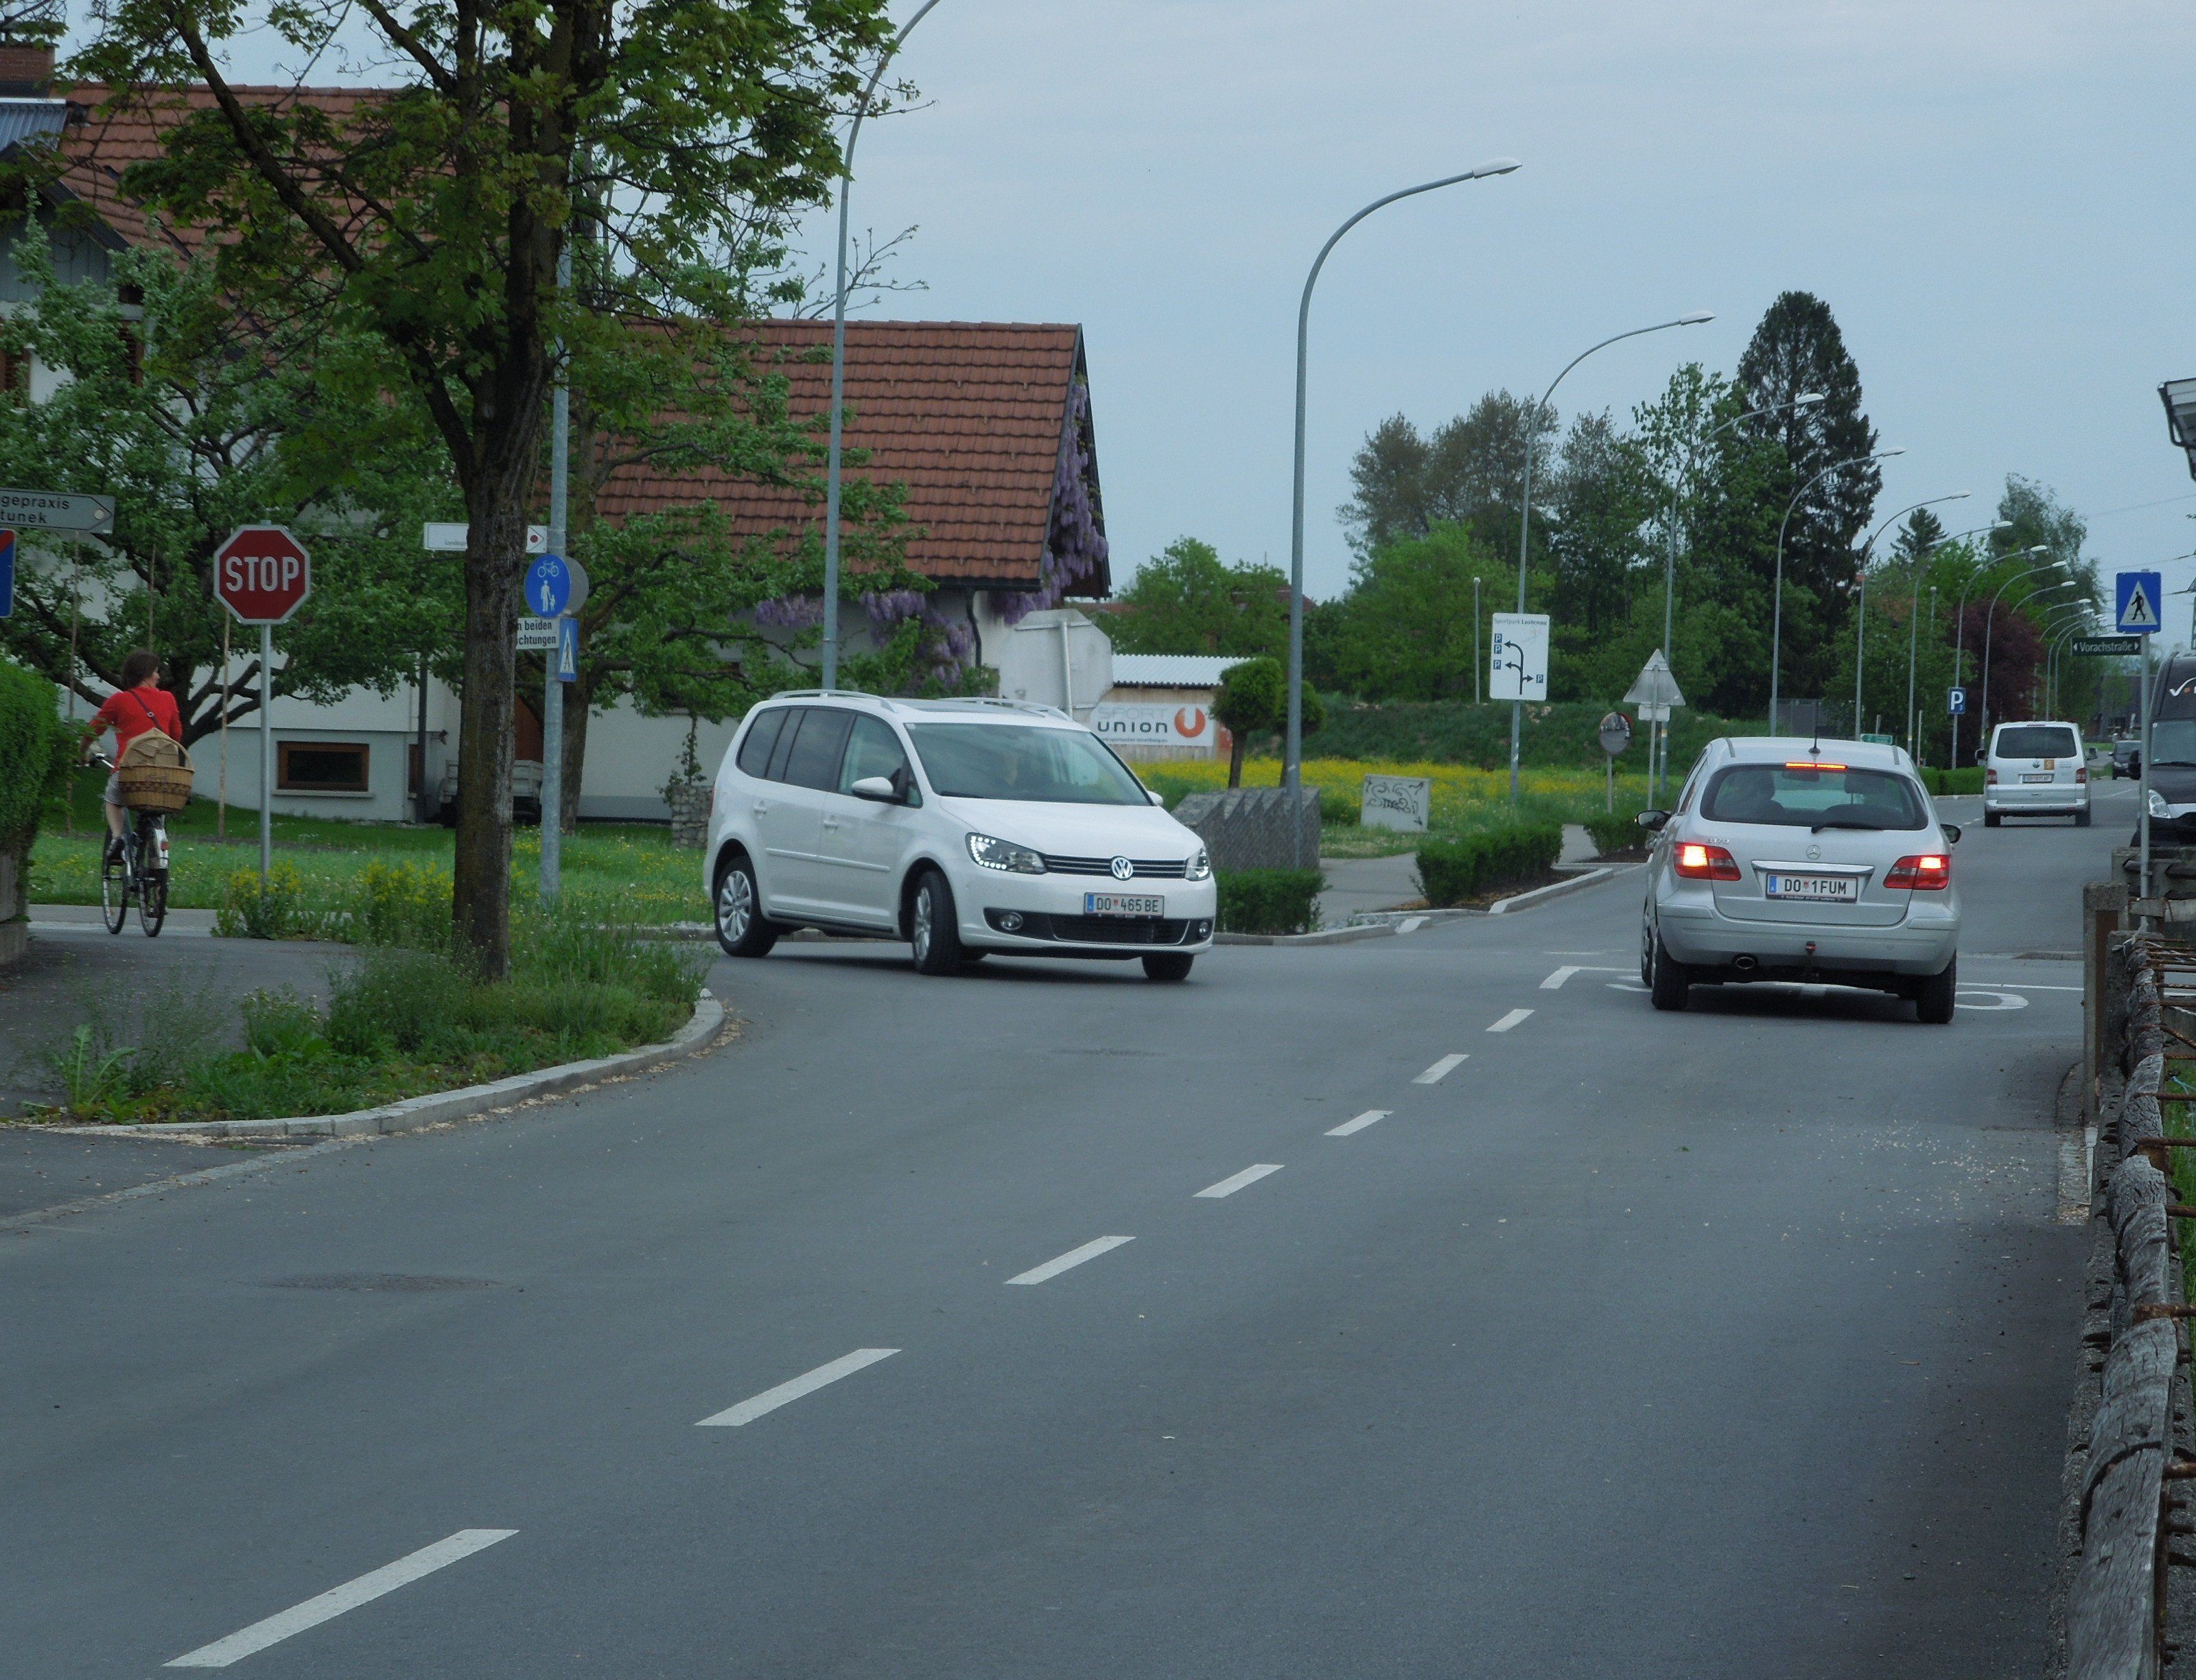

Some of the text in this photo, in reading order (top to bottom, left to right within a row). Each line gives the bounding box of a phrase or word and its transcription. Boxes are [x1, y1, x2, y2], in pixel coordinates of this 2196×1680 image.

[226, 556, 299, 592] STOP
[524, 620, 552, 631] beiden
[2079, 640, 2132, 652] Vorachstraße
[1950, 690, 1963, 710] P
[1097, 721, 1168, 734] union
[1784, 878, 1801, 893] DO
[1097, 897, 1111, 911] DO
